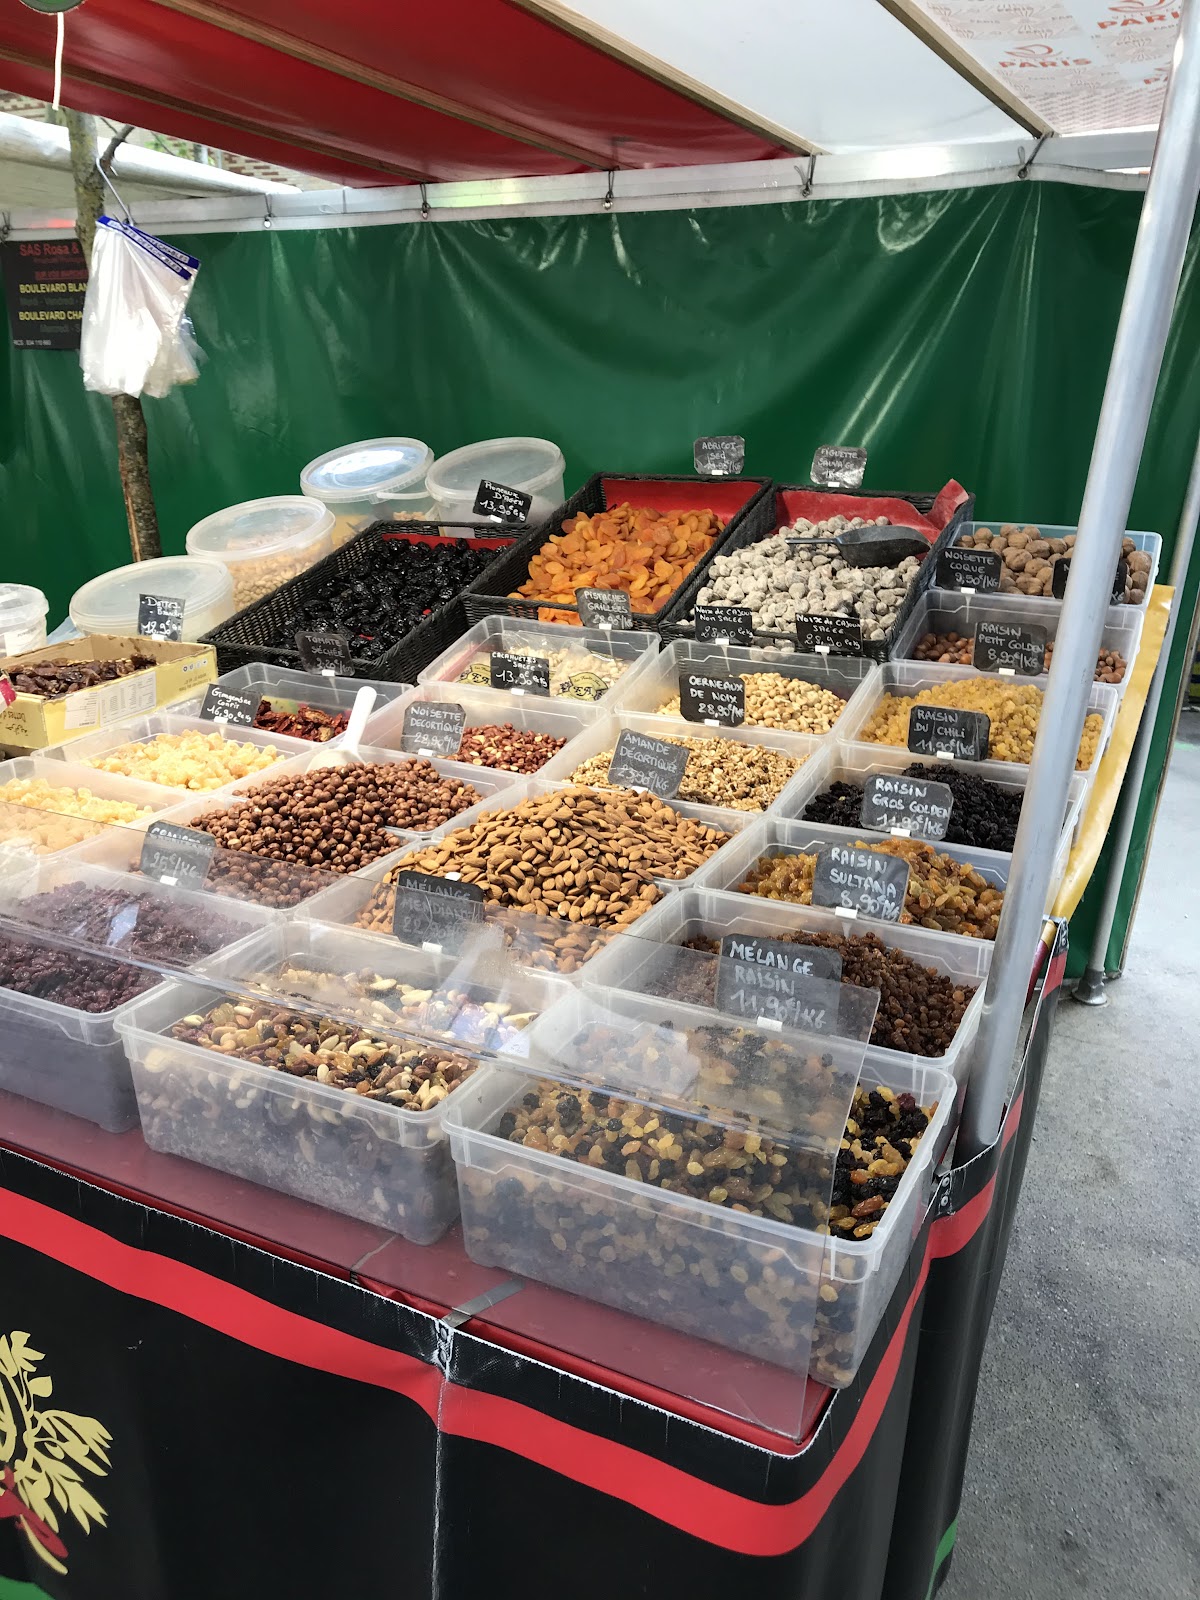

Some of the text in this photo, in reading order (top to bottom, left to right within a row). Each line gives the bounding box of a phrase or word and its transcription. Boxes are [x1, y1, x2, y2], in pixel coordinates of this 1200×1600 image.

[1097, 11, 1181, 30] PARI
[998, 57, 1093, 69] PARIS
[20, 242, 80, 257] SAS Rosa &
[20, 283, 67, 294] BOULEVARD
[19, 311, 66, 321] BOULEVARD
[949, 561, 986, 574] COQUE
[304, 635, 343, 648] TOMATE
[690, 687, 738, 704] DE NOIX
[913, 722, 929, 733] DU
[624, 732, 670, 756] AMANDE
[872, 793, 950, 819] GROS GOLDEN
[829, 867, 897, 899] SULTANA
[729, 940, 814, 977] MÉLANGE
